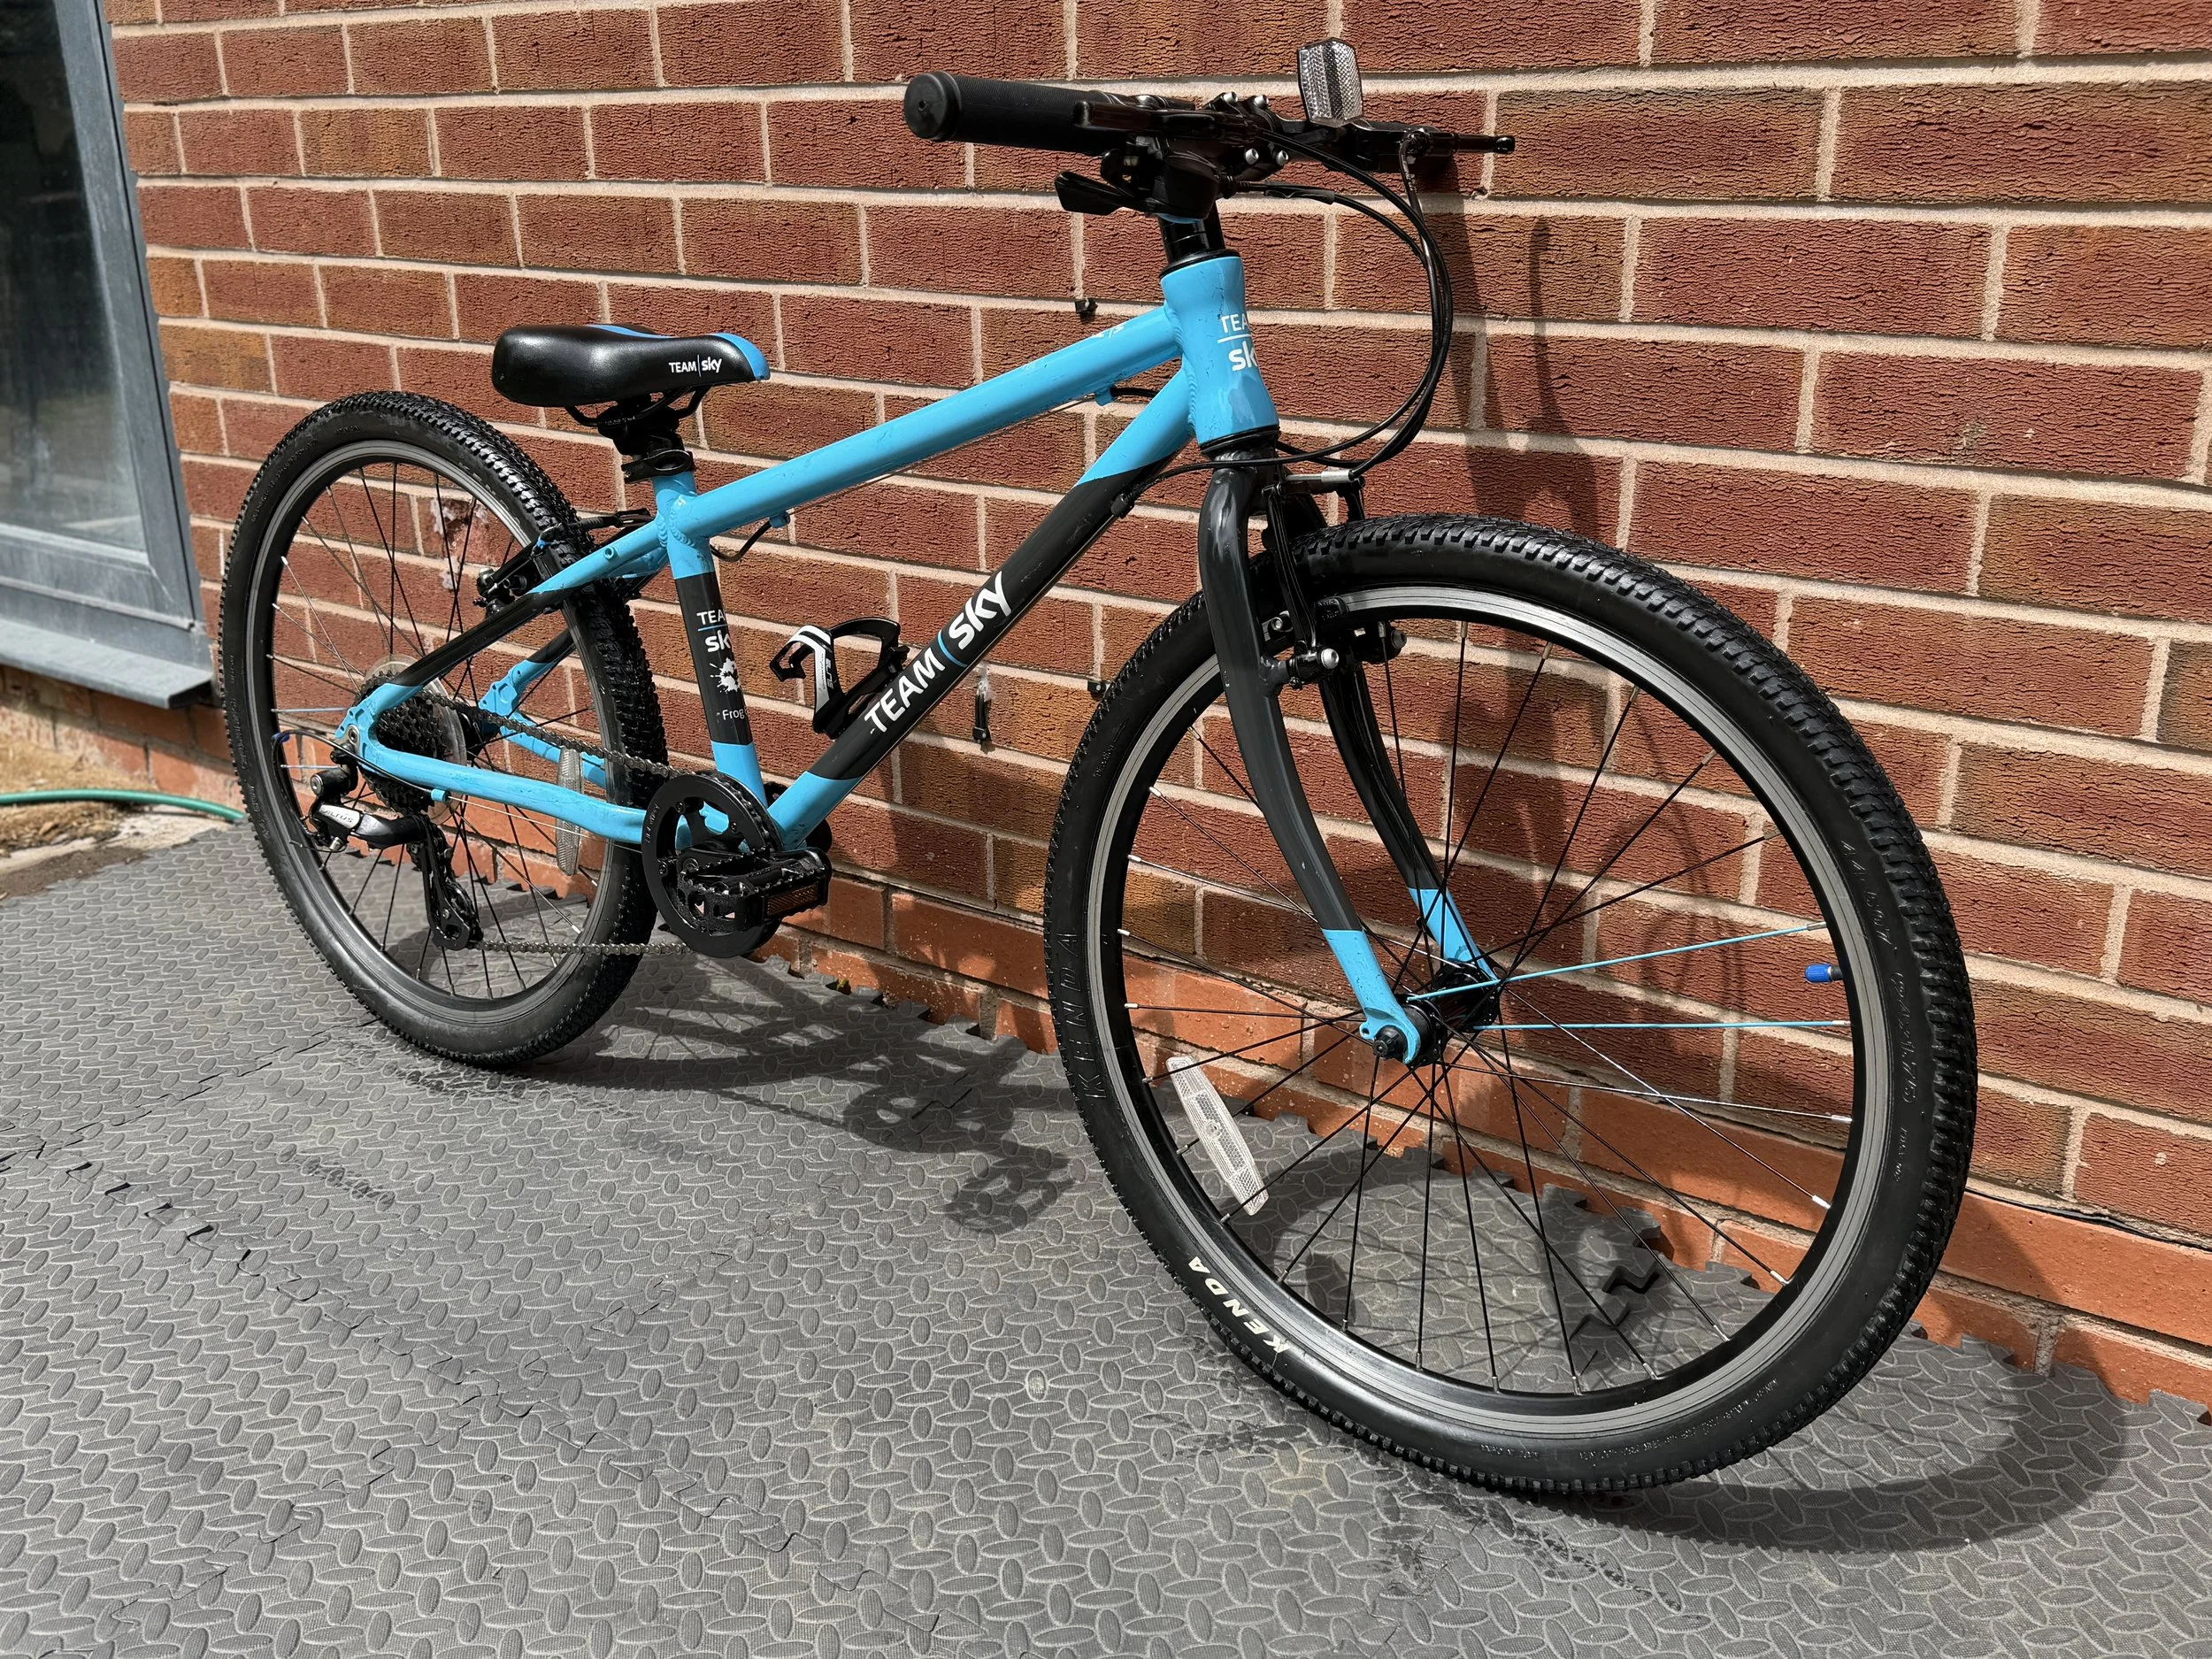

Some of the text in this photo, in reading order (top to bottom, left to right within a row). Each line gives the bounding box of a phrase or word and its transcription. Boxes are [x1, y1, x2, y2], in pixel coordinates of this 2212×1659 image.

[1220, 313, 1249, 334] TEA
[668, 361, 697, 373] TEAM
[1228, 340, 1259, 372] sk
[696, 609, 726, 626] TEA
[704, 629, 732, 653] sk
[864, 647, 946, 733] TEAM
[722, 709, 745, 721] Frog
[1056, 932, 1107, 1099] KENDA
[1187, 1256, 1292, 1355] KENDA
